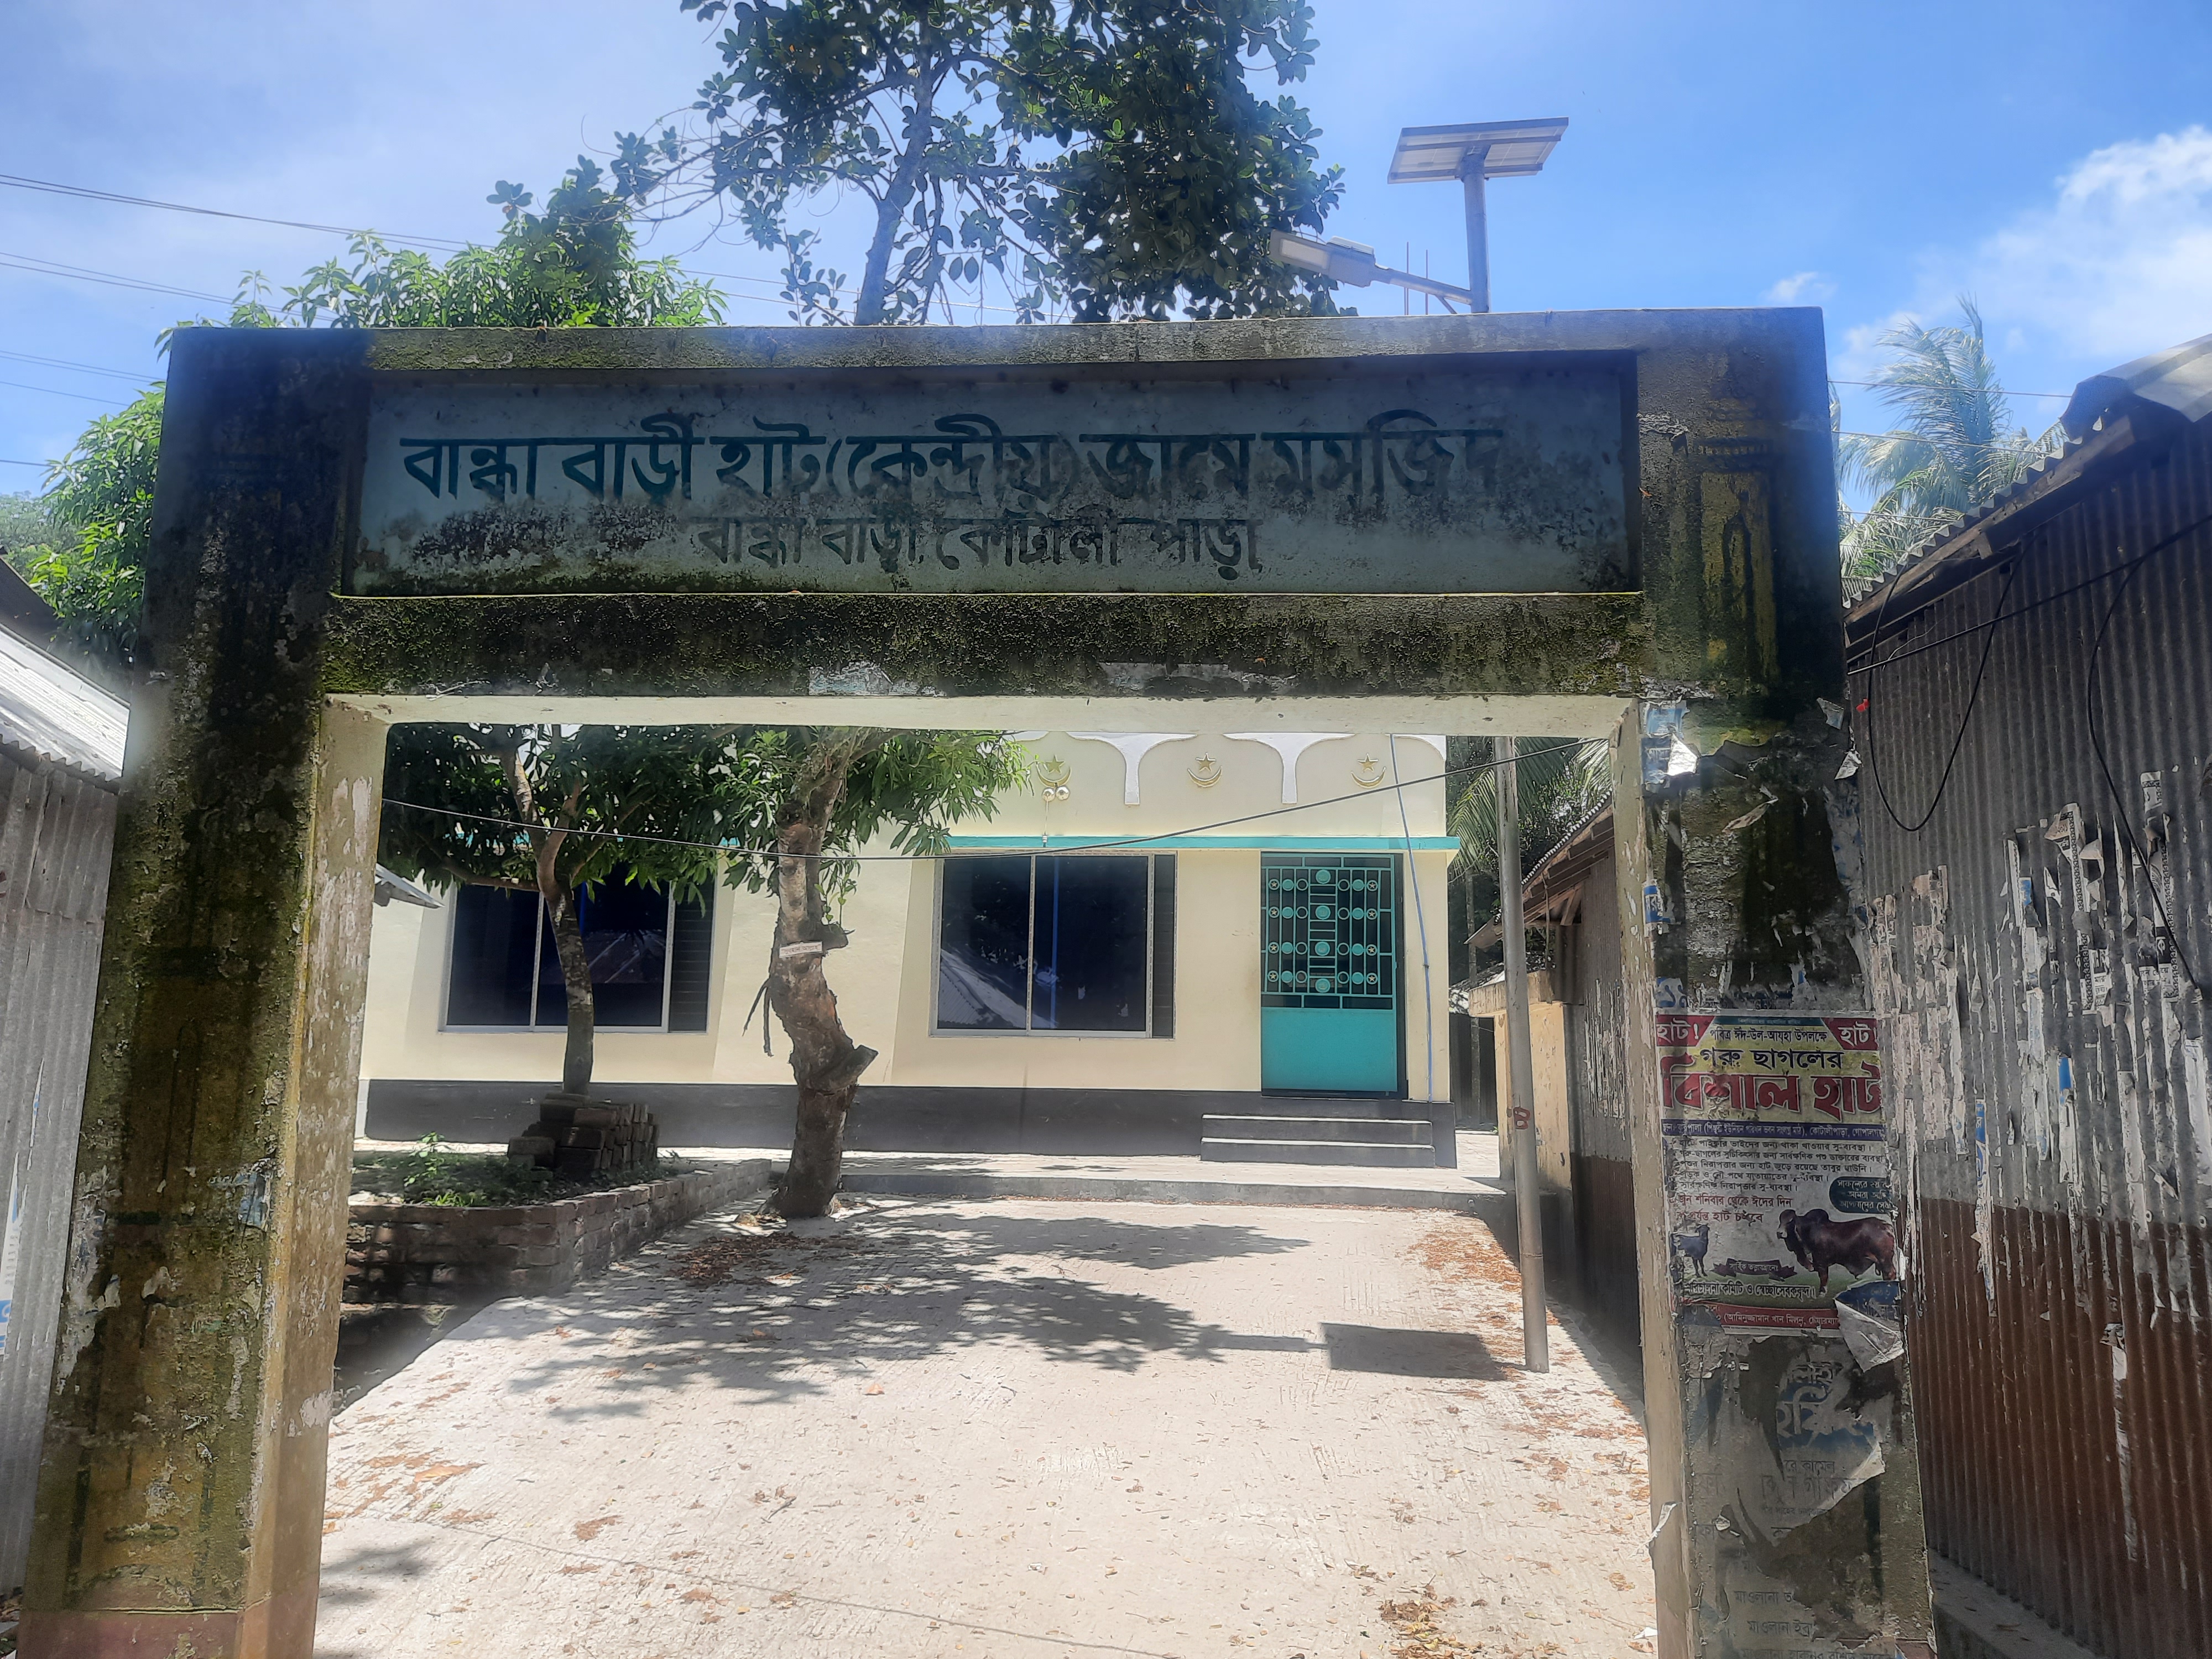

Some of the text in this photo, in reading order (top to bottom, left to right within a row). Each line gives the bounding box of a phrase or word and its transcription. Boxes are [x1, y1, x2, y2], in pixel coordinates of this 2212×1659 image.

[709, 415, 826, 501] হাট
[1079, 433, 1255, 500] জামে
[1261, 409, 1503, 499] মসজিদ
[1710, 1026, 1731, 1041] পবিত্র
[1793, 1027, 1828, 1042] উপলক্ষে
[1700, 1047, 1844, 1070] গরু ছাগলের
[1660, 1052, 1881, 1123] বিশাল হাট
[1729, 1140, 1760, 1149] ভাইদের
[1801, 1142, 1830, 1151] খাওয়ার
[1762, 1151, 1778, 1160] জন্য
[1779, 1150, 1813, 1160] সার্বক্ষণিক
[1828, 1154, 1860, 1162] ডাক্তারের
[1700, 1159, 1736, 1168] নিরাপত্তার
[1757, 1161, 1771, 1170] হাট
[1773, 1163, 1792, 1171] জুড়ে
[1793, 1163, 1818, 1172] রয়েছে
[1712, 1171, 1724, 1179] নৌ
[1720, 1180, 1756, 1190] নিরাপত্তার
[1837, 1180, 1868, 1191] সাফল্যের
[1694, 1192, 1725, 1206] শনিবার
[1728, 1196, 1749, 1206] থেকে
[1751, 1194, 1774, 1207] ঈদের
[1776, 1194, 1793, 1208] দিন
[1847, 1191, 1869, 1199] আমরা
[1712, 1209, 1732, 1223] হাট
[1720, 1279, 1744, 1295] কমিটি
[1745, 1284, 1754, 1295] ও
[1801, 1460, 1835, 1474] কামেল
[1734, 1590, 1779, 1605] মাওলানা
